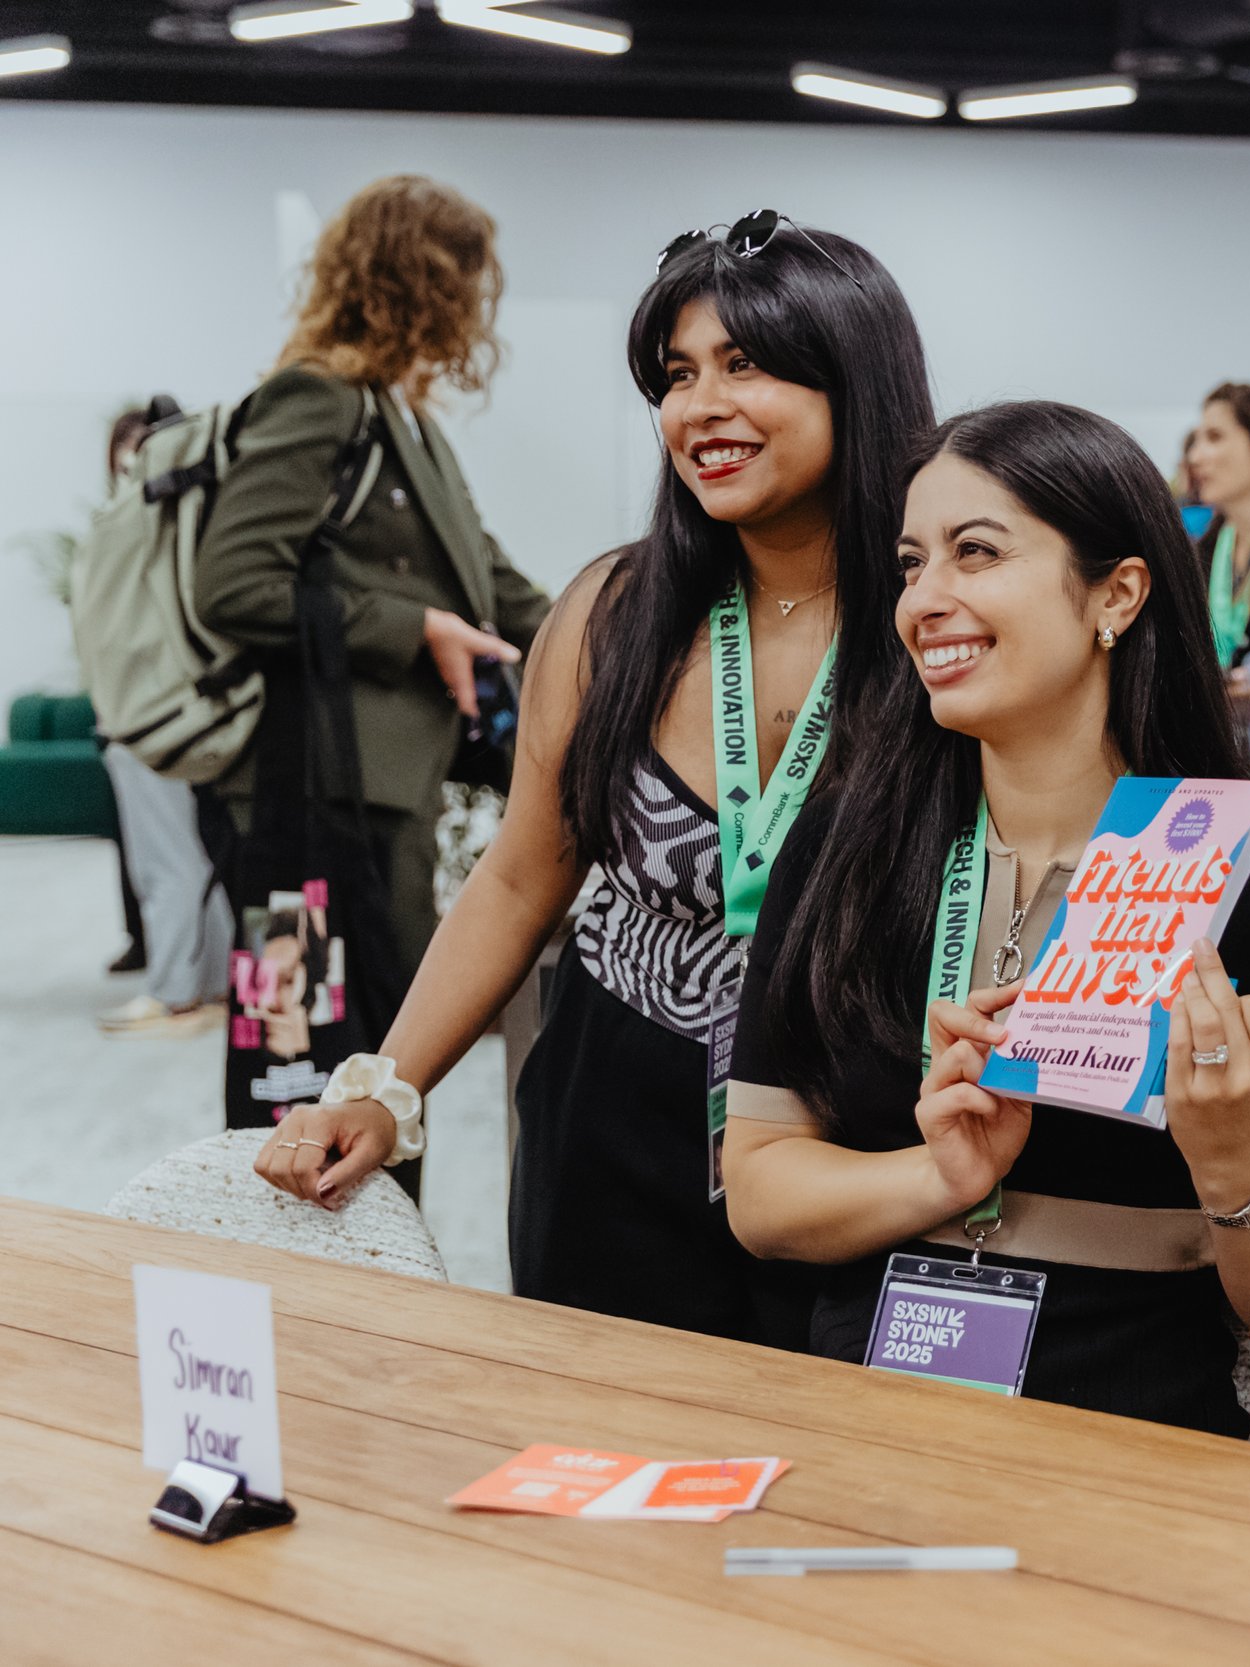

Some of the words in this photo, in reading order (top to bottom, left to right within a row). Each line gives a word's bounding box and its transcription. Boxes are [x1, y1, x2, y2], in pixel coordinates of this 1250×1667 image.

[720, 635, 746, 766] INNOVATION
[786, 719, 826, 780] SXSW
[758, 792, 790, 846] CommBank
[952, 820, 976, 874] ECH
[949, 877, 972, 896] &
[1065, 844, 1233, 905] Friends
[938, 901, 969, 1003] INNOVAT
[1090, 896, 1185, 954] that
[1022, 938, 1196, 1012] Invest
[1018, 1010, 1034, 1019] Your
[1034, 1010, 1055, 1021] guide
[1057, 1012, 1065, 1020] to
[1065, 1012, 1100, 1023] financial
[1101, 1014, 1161, 1029] independence
[1030, 1023, 1060, 1034] through
[1061, 1026, 1085, 1035] shares
[1086, 1026, 1103, 1036] and
[1104, 1028, 1130, 1039] stocks
[1005, 1039, 1079, 1067] Simran
[1080, 1045, 1141, 1073] Kaur
[888, 1320, 965, 1348] SYDNEY
[892, 1299, 949, 1325] SXSW
[168, 1327, 254, 1402] Simran
[882, 1341, 934, 1365] 2025
[185, 1412, 241, 1463] Kaur
